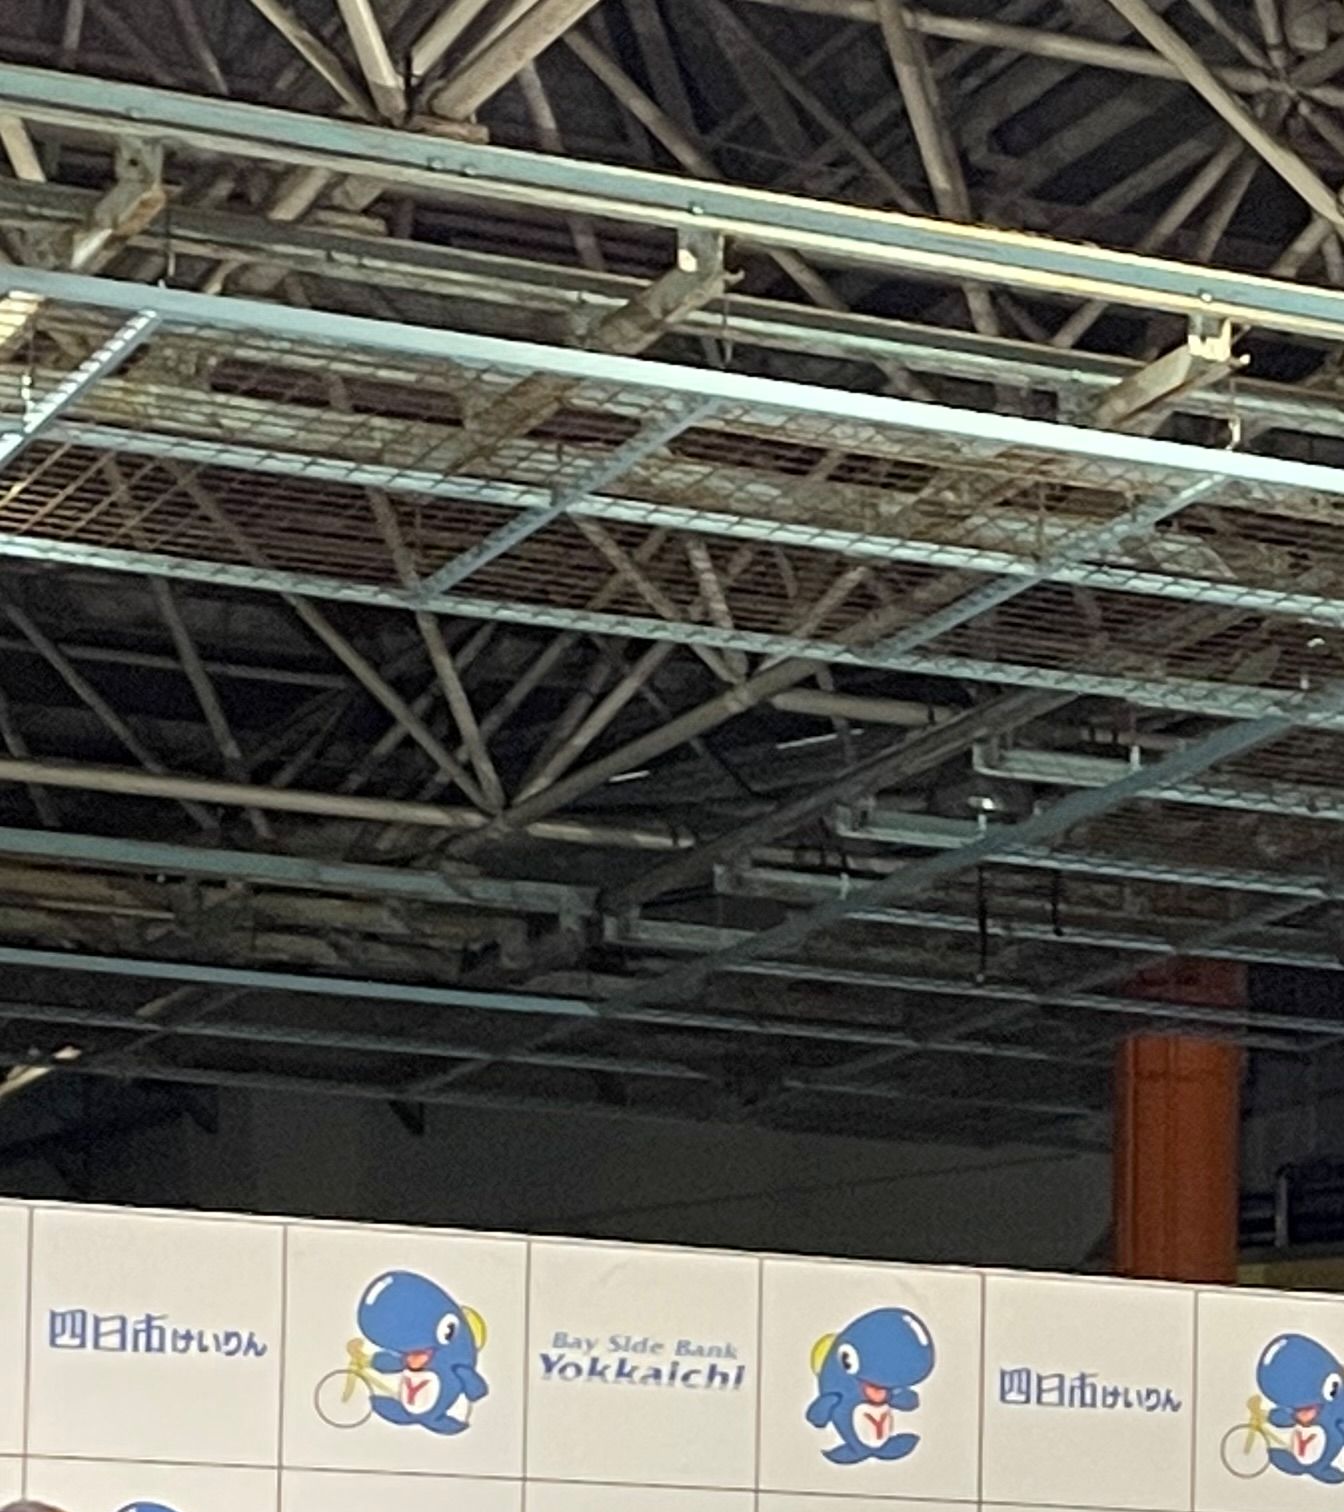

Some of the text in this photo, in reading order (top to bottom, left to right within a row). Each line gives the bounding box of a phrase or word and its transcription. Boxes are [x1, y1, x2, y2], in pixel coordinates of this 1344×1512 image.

[49, 1309, 267, 1357] 四日市けいりん
[551, 1331, 738, 1360] Bay Side Bank
[539, 1353, 745, 1390] Yokkaichi
[404, 1377, 431, 1405] Y
[1000, 1368, 1182, 1412] 四日市けいりん
[863, 1411, 888, 1440] Y
[1297, 1429, 1316, 1456] Y
